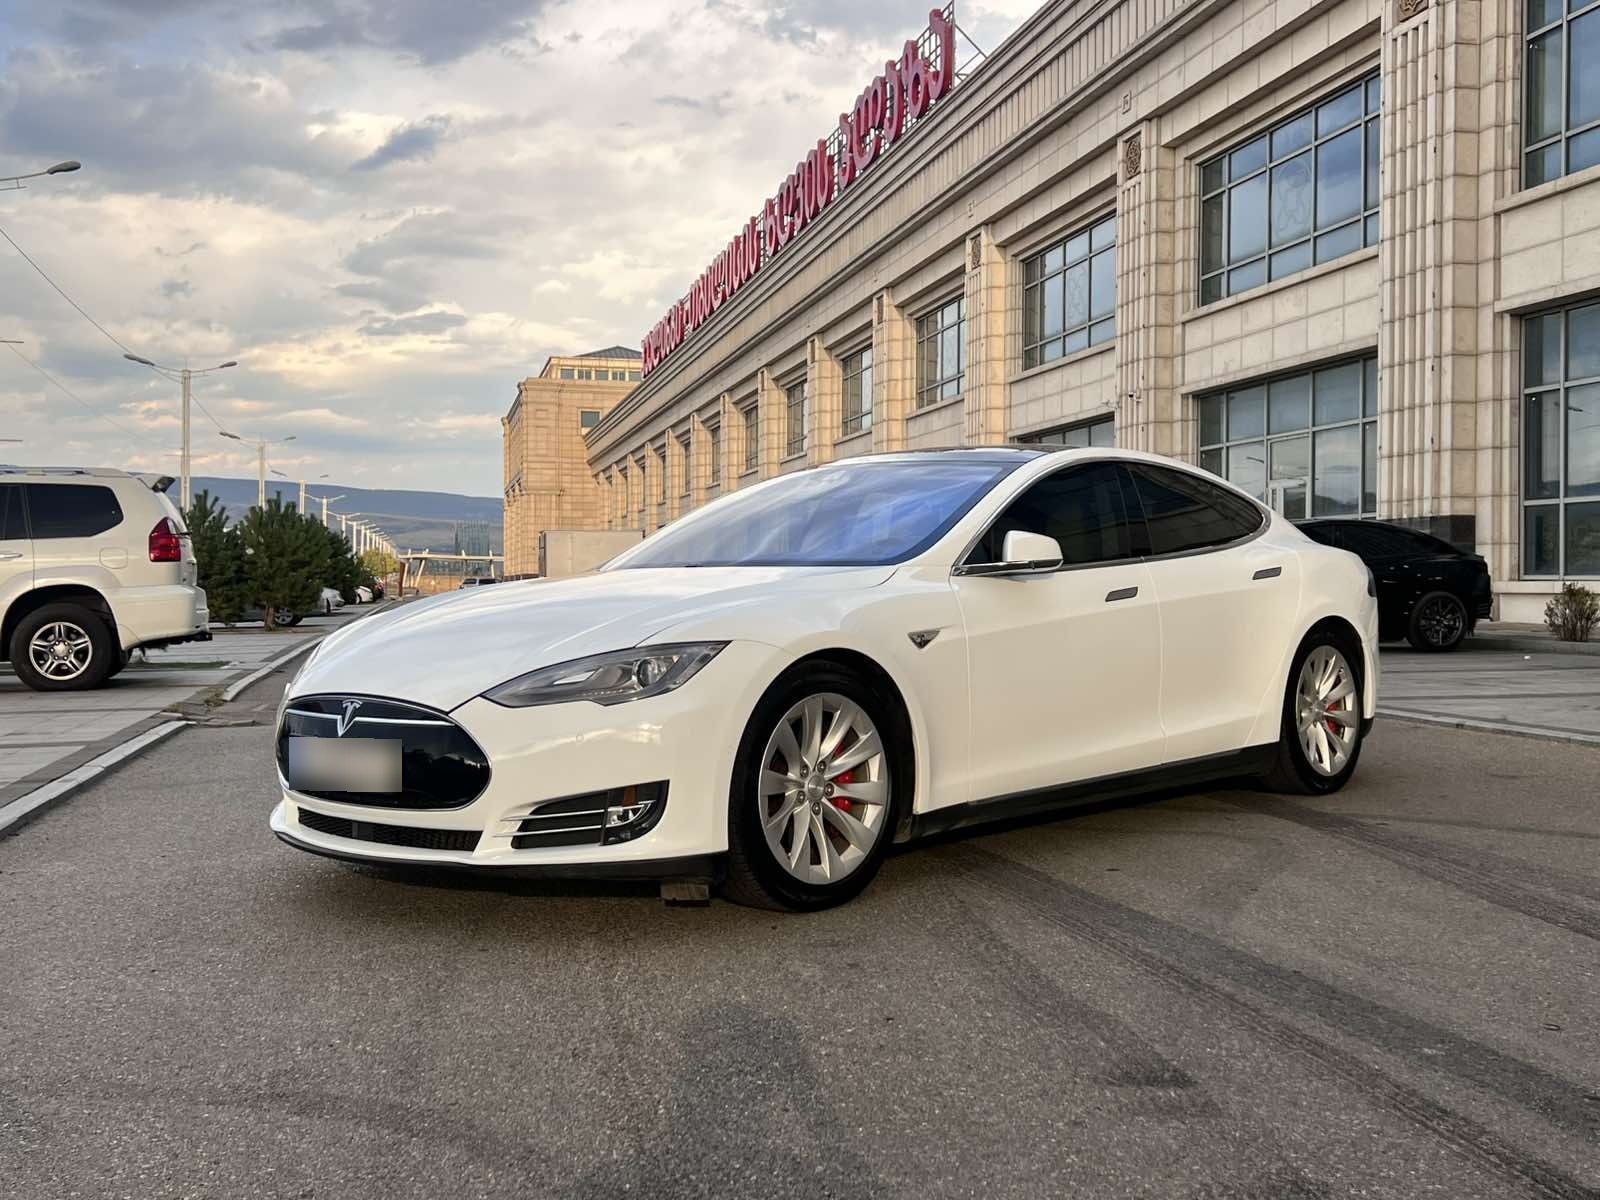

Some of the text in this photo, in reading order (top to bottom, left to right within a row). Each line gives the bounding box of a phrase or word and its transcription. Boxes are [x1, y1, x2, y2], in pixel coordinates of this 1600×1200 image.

[687, 216, 761, 332] თბილისის
[764, 139, 834, 257] ზღვის
[839, 8, 950, 190] პლაზა
